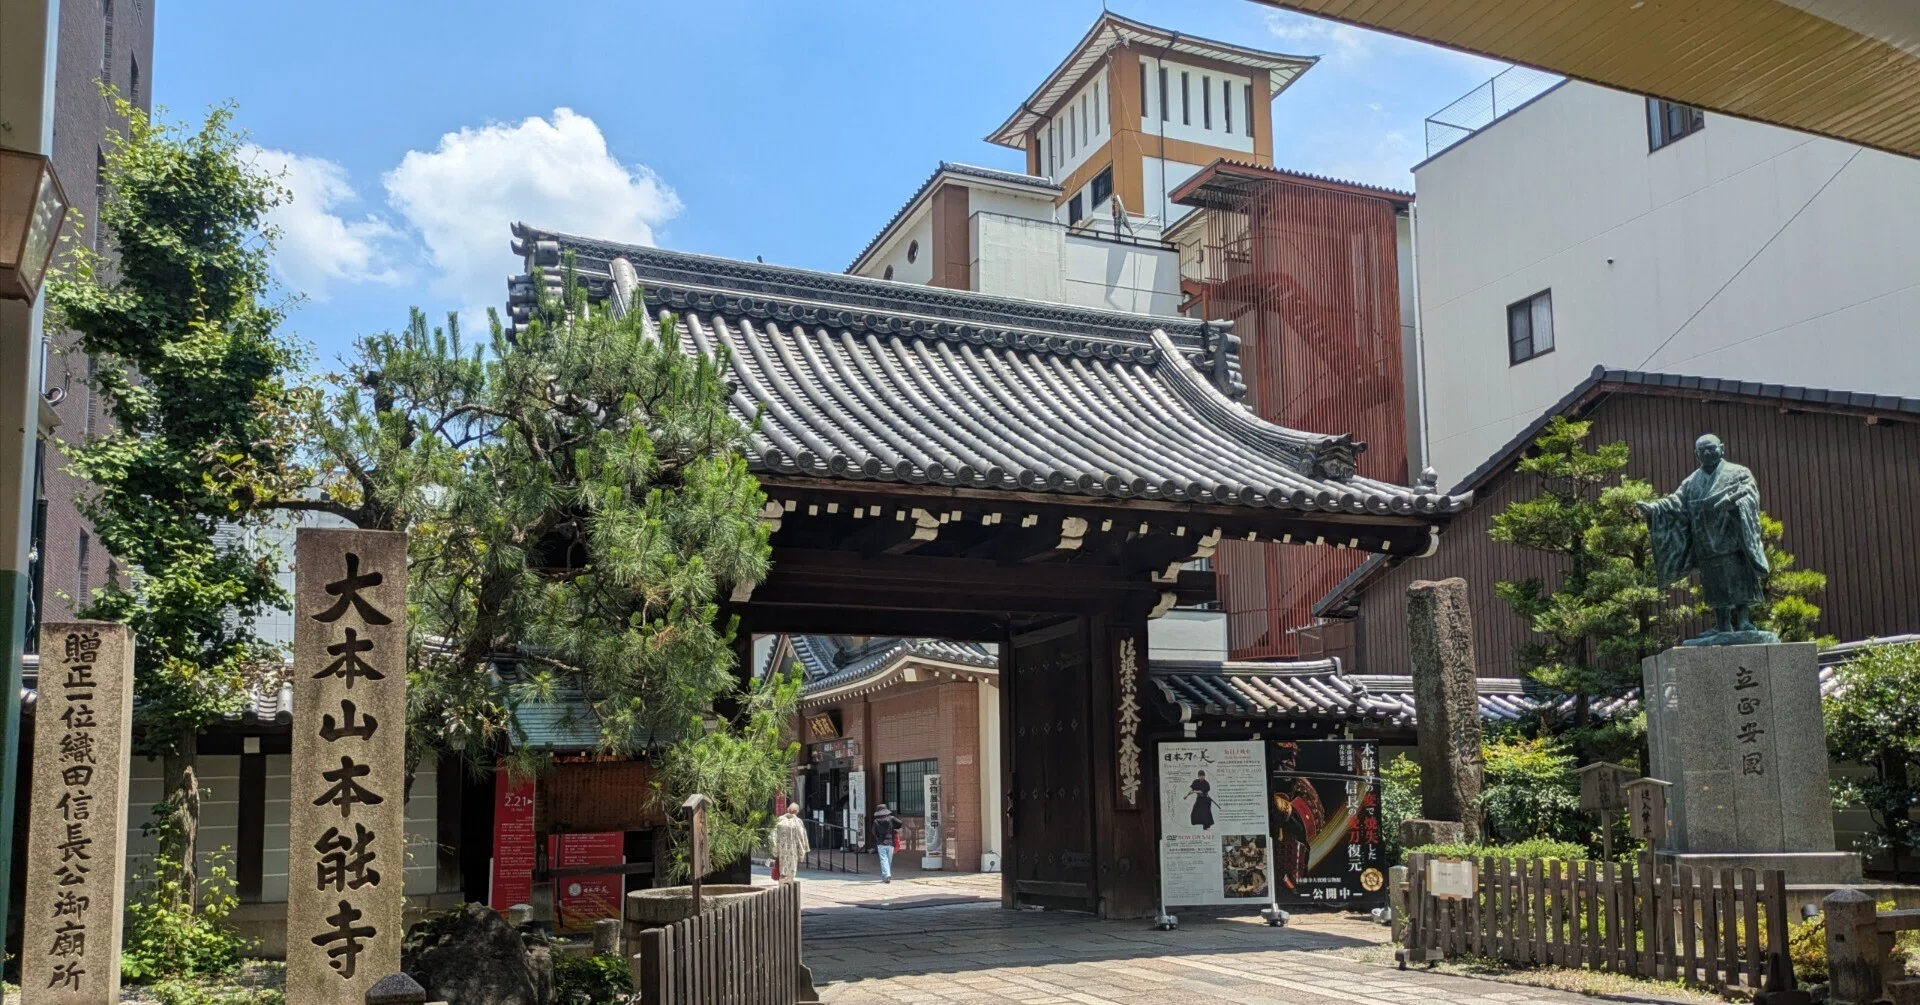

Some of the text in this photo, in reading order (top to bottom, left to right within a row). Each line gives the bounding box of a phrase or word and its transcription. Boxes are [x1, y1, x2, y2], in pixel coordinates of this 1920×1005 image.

[47, 632, 103, 993] 贈正一位織田信長公御廟所
[311, 552, 393, 979] 大本山本能寺
[504, 796, 527, 807] 2.21
[1361, 743, 1379, 860] 本能寺の変で焼失した
[1344, 780, 1362, 872] 信長の愛刀復元
